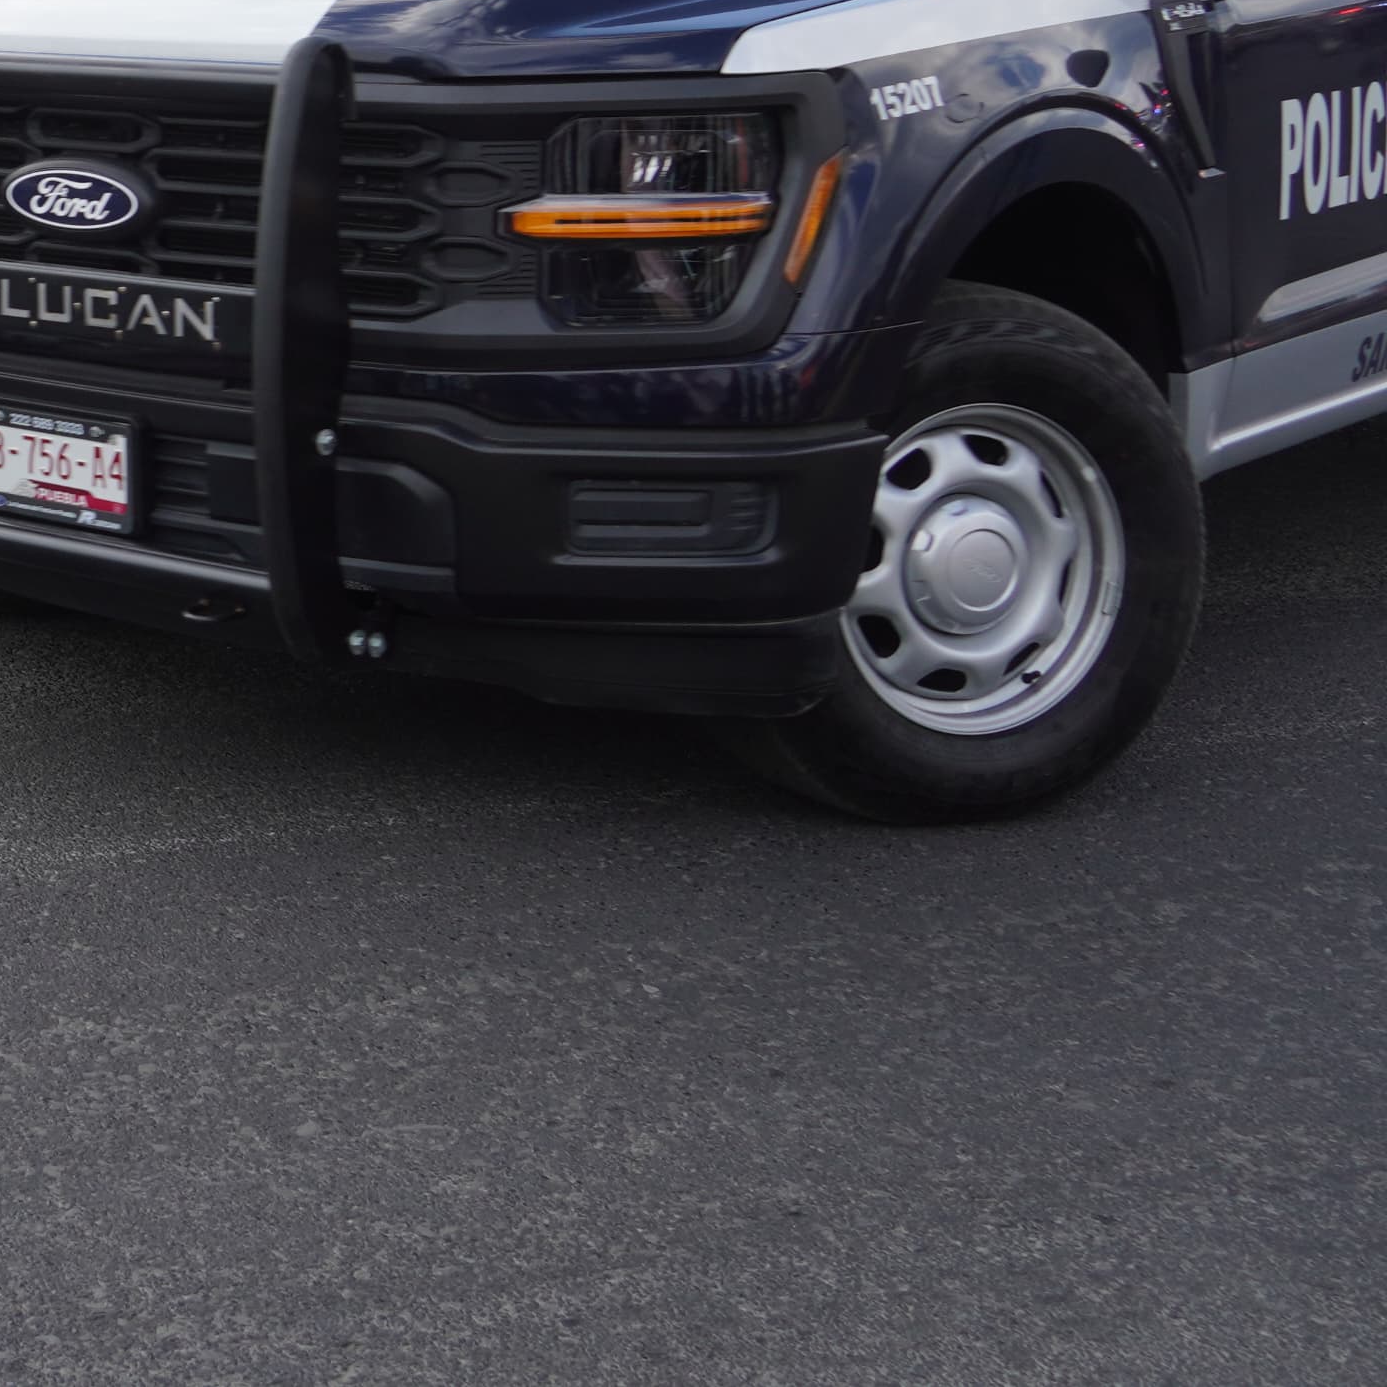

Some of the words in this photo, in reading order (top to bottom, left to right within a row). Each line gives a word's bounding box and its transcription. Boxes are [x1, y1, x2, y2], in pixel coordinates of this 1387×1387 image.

[869, 76, 945, 120] 15207
[30, 176, 112, 221] Ford
[35, 487, 89, 507] PUEBLA
